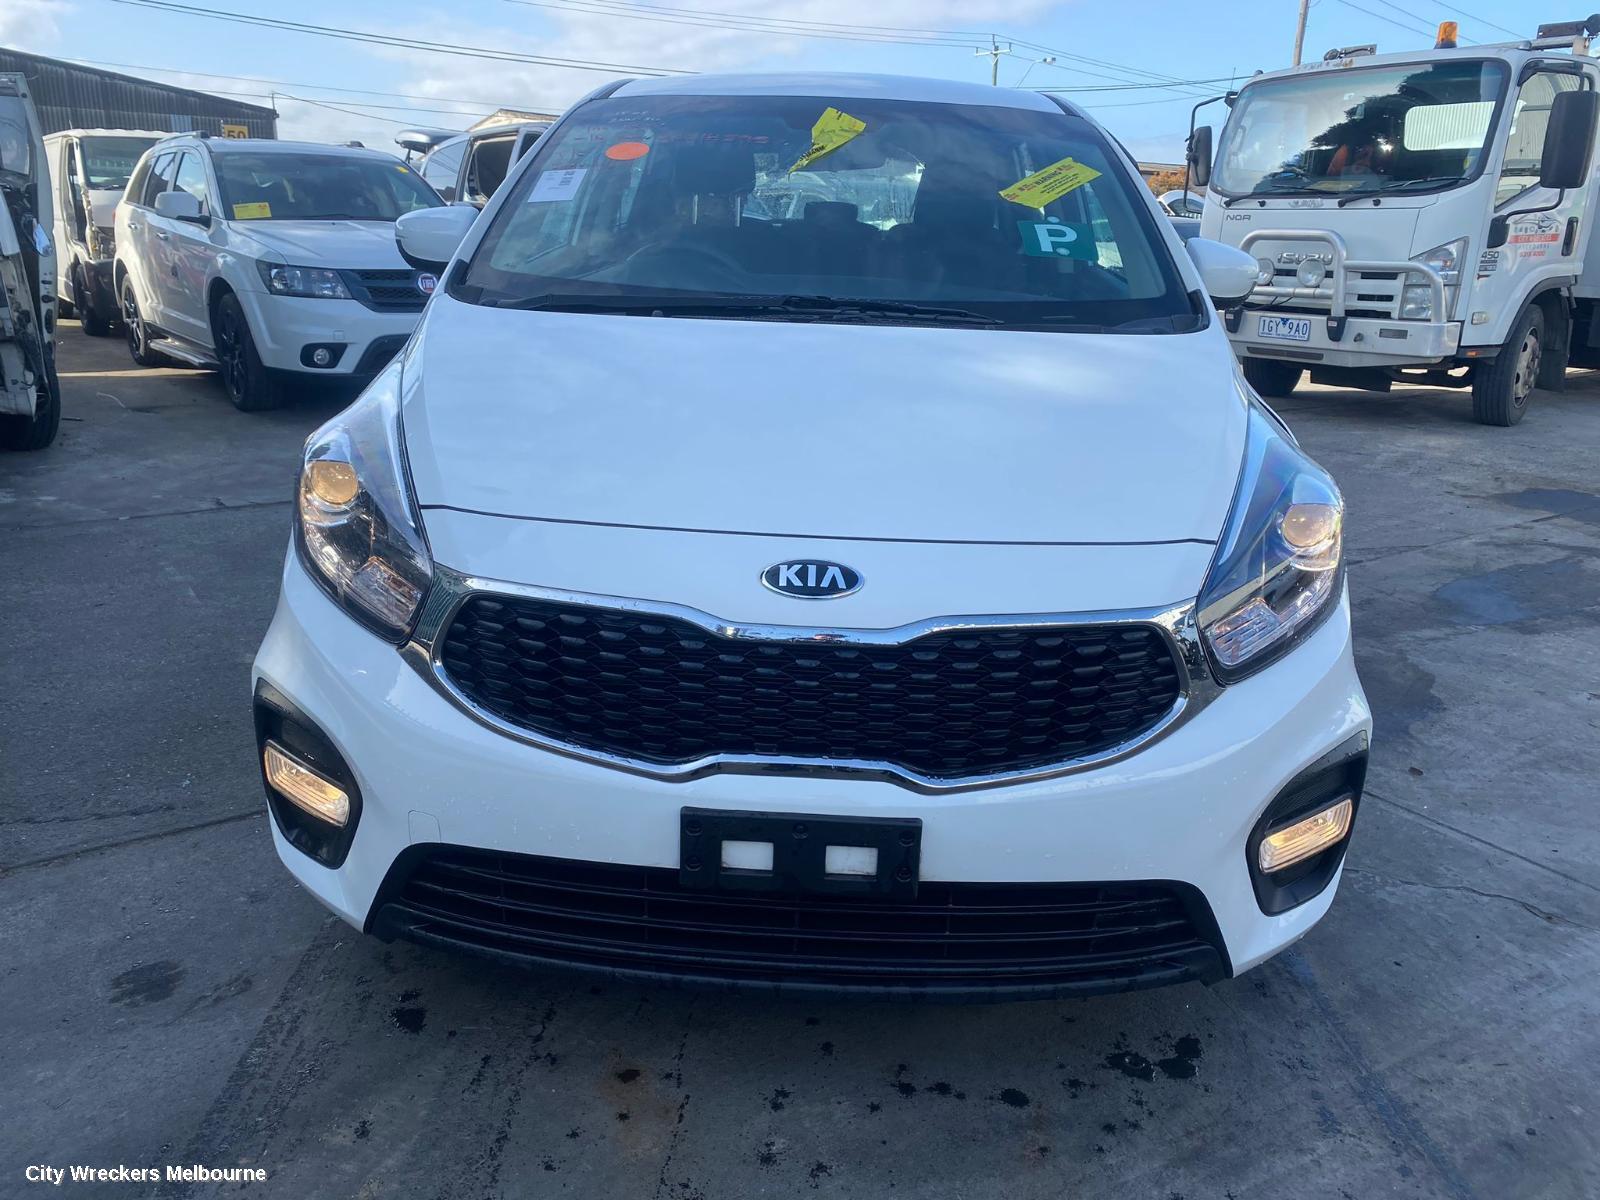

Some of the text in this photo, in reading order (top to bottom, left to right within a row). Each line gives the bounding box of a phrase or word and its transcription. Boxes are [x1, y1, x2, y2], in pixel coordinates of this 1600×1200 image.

[1034, 224, 1077, 252] P
[1481, 251, 1499, 260] 450
[779, 564, 847, 589] KIA
